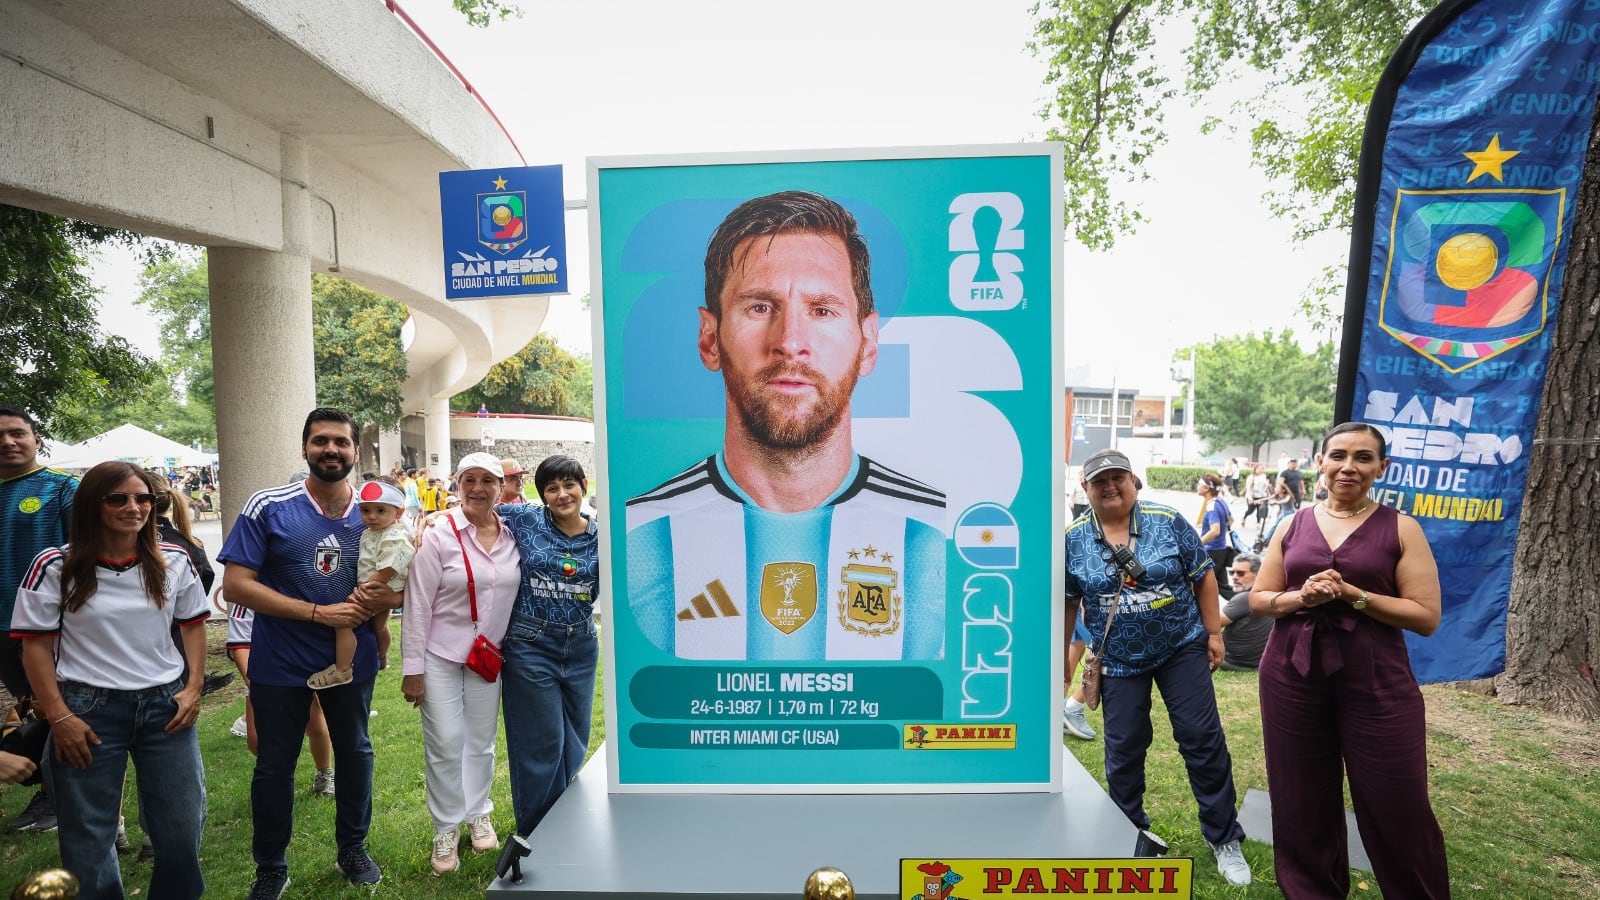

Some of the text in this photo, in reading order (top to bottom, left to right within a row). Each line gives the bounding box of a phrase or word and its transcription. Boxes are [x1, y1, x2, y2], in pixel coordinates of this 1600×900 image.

[1414, 92, 1592, 121] BIENVENIDO
[451, 257, 558, 277] SAN PEDRO
[452, 273, 558, 290] CIUDAD DE NIVEL MUNDIAL
[970, 287, 1004, 300] FIFA
[1363, 389, 1475, 429] SAN
[1436, 466, 1470, 492] DE
[1125, 560, 1136, 570] 10
[851, 582, 887, 616] AFA
[1121, 605, 1130, 614] DE
[1130, 603, 1151, 613] NIVEL
[776, 608, 801, 617] FIFA
[717, 672, 854, 693] LIONEL MESSI
[690, 700, 762, 715] 24-6-1987
[777, 700, 807, 717] 1,70
[809, 703, 824, 715] m
[839, 700, 857, 715] 72
[860, 699, 879, 718] kg
[690, 728, 840, 746] INTER MIAMI CF (USA)
[935, 727, 1012, 740] PANINI
[982, 867, 1180, 894] PANINI
